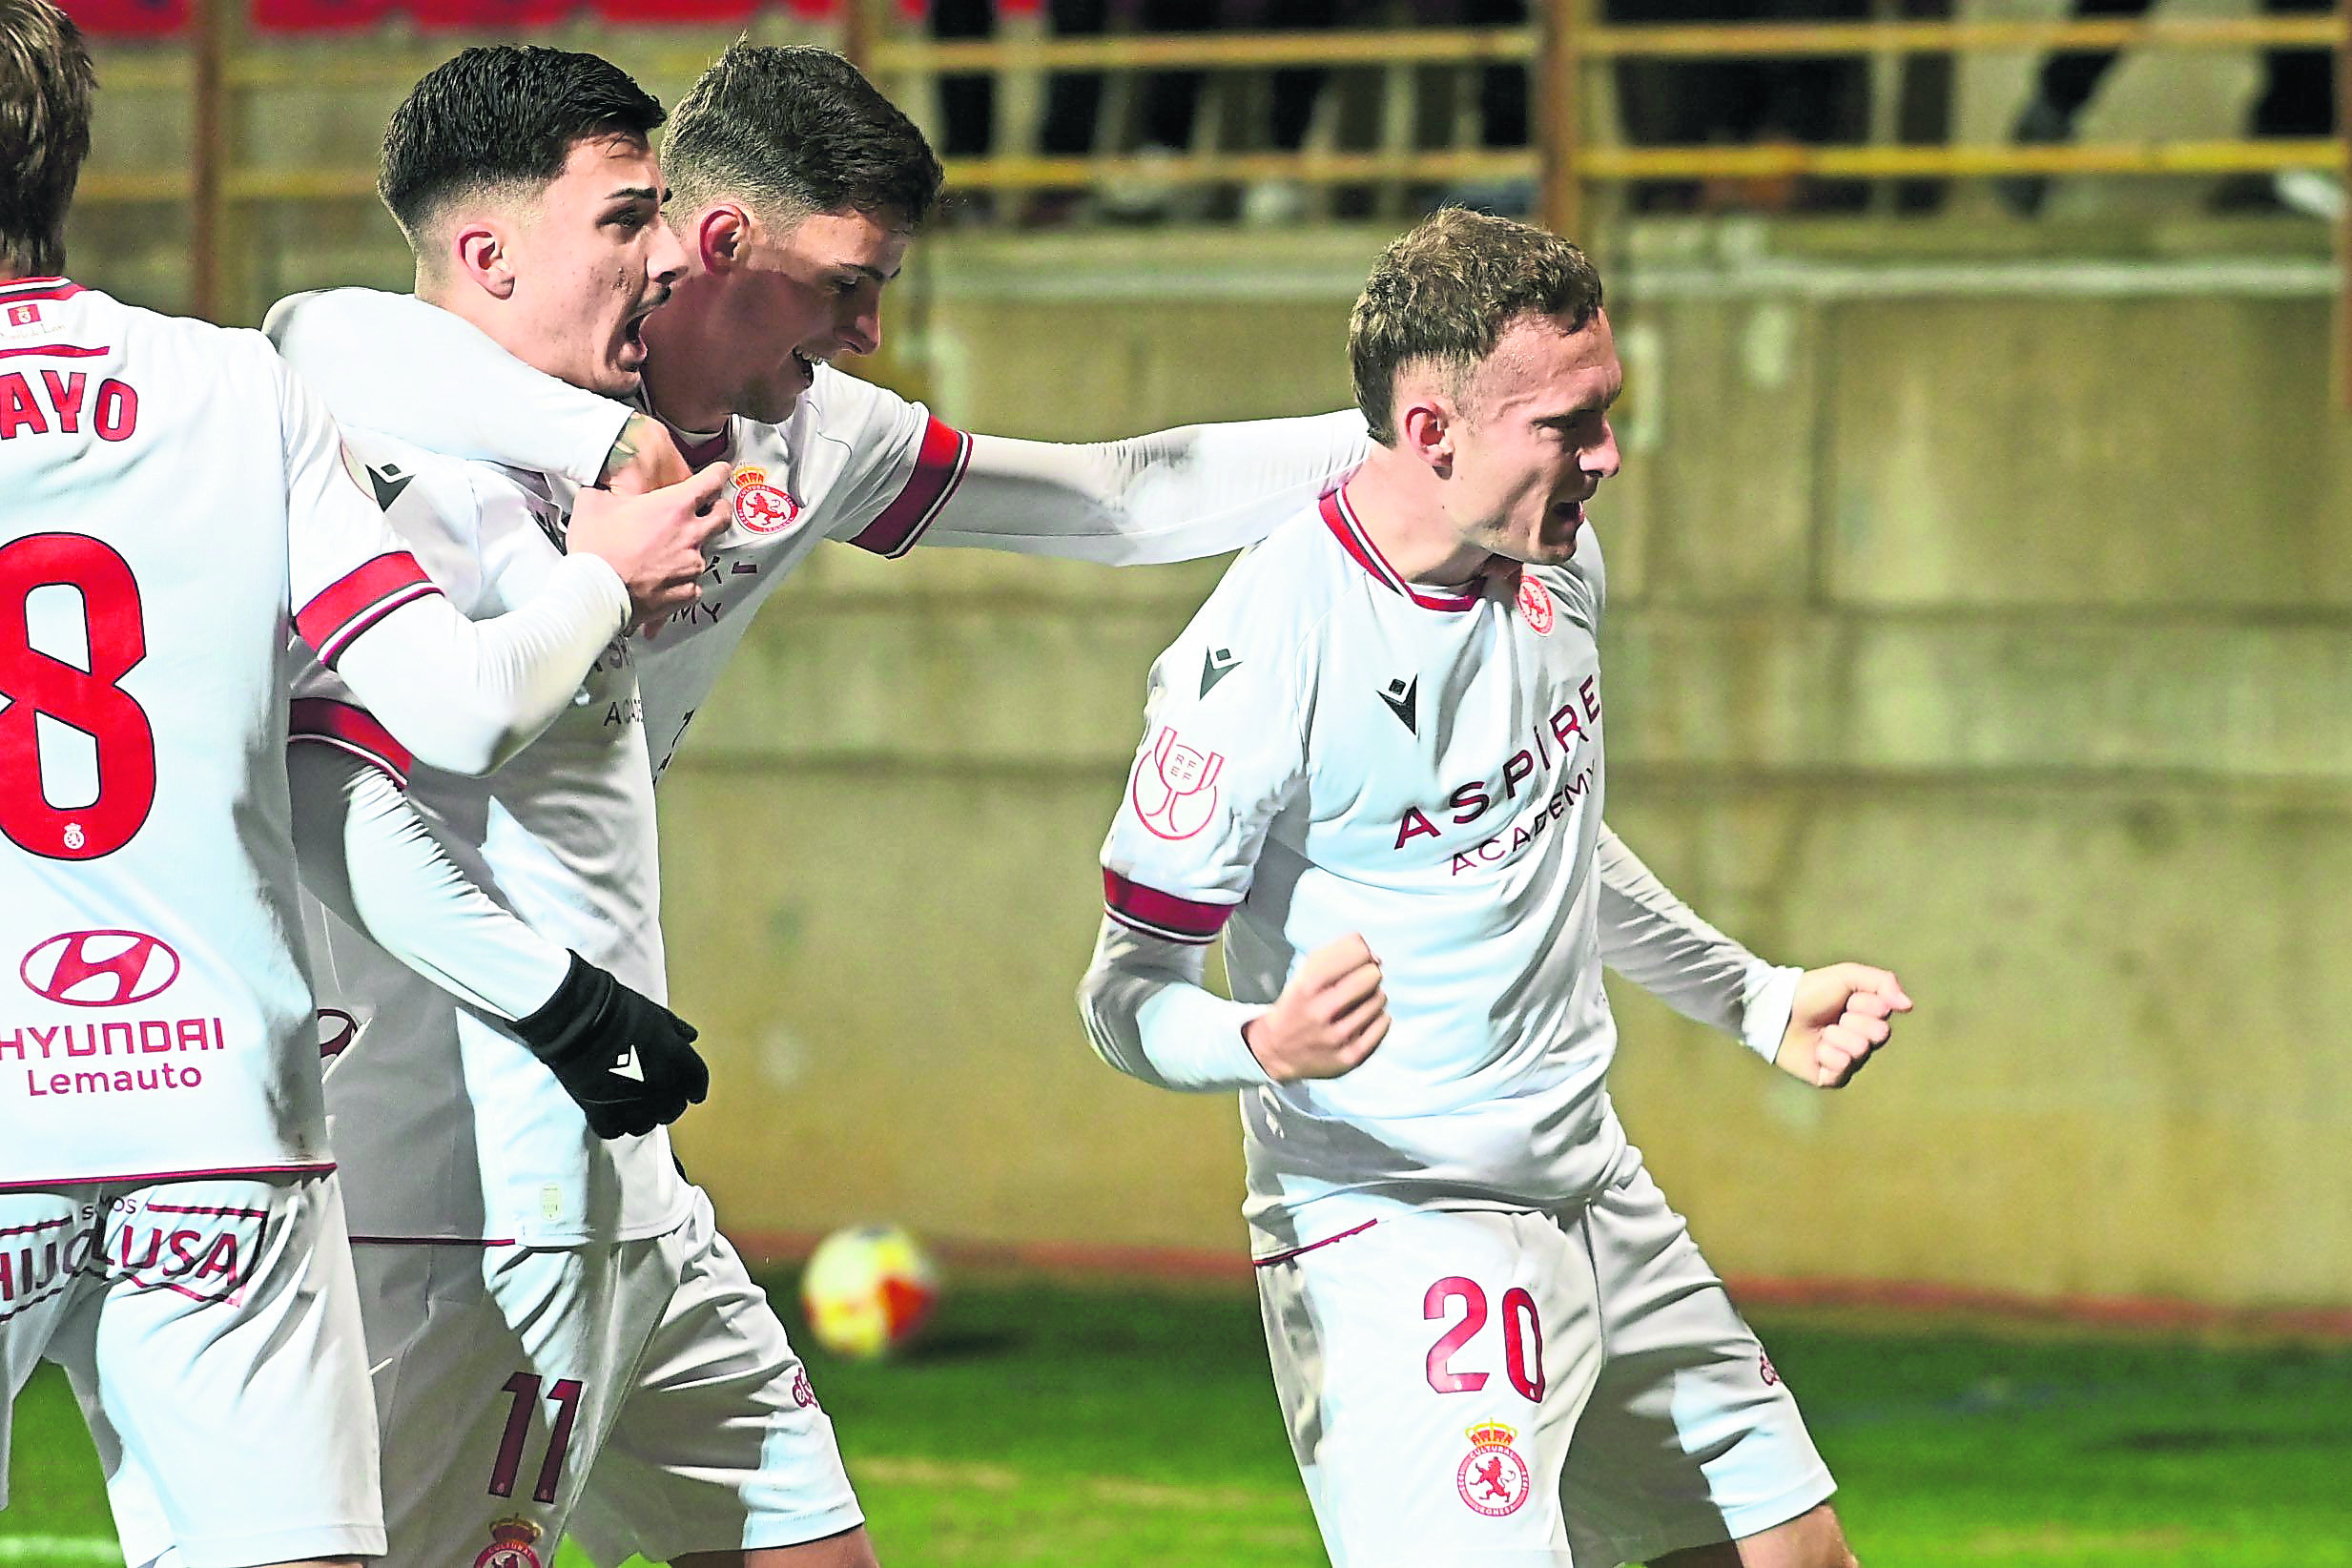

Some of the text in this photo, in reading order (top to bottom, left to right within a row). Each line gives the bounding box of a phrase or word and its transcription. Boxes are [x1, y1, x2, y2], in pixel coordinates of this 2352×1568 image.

[0, 369, 139, 442] AYO
[0, 532, 156, 860] 8
[0, 1018, 224, 1061] HYUNDAI
[28, 1063, 201, 1096] Lemauto
[1423, 1275, 1546, 1404] 20
[488, 1372, 584, 1504] 11
[1469, 1445, 1516, 1459] CULTURAL
